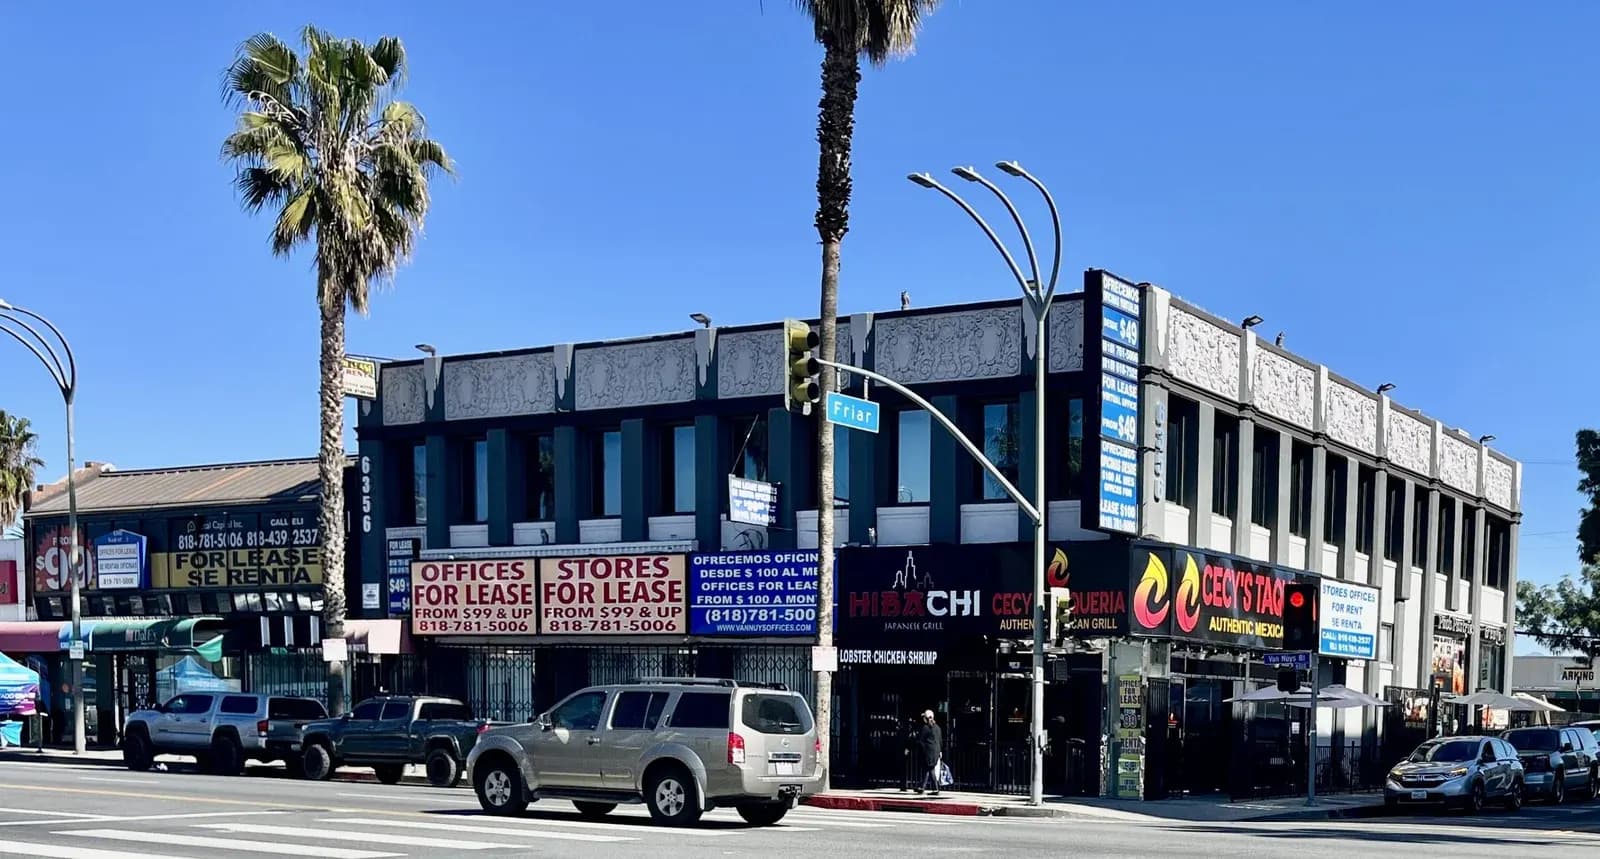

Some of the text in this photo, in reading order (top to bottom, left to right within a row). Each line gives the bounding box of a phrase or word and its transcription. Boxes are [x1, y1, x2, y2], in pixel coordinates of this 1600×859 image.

[1120, 317, 1137, 346] $49
[1103, 375, 1138, 398] FOR LEASE
[834, 401, 872, 423] Friar
[1118, 413, 1136, 442] $49
[362, 456, 372, 533] 6356
[1100, 499, 1119, 515] LEASE
[271, 517, 304, 527] CALL ELI
[53, 537, 73, 547] FRO
[176, 548, 319, 572] FOR LEASE
[693, 553, 818, 566] OFRECEMOS OFICIN
[421, 562, 525, 582] OFFICES
[557, 557, 670, 580] STORES
[700, 566, 818, 579] DESDE $ 100 AL ME
[187, 566, 312, 588] SE RENTA
[389, 578, 406, 593] $49
[544, 580, 682, 604] FOR LEASE
[701, 580, 818, 592] OFFICES FOR LEAS
[1202, 563, 1285, 618] CECY'S TAQ
[414, 583, 533, 606] FOR LEASE
[696, 594, 818, 605] FROM $ 100 A MON
[1322, 585, 1376, 603] STORES OFFICES
[849, 589, 981, 617] HIBACHI
[992, 592, 1033, 616] CECY
[1332, 602, 1363, 616] FOR RENT
[415, 607, 533, 619] FROM $99 & UP
[544, 606, 682, 619] FROM $99 & UP
[705, 608, 816, 625] (818)781-500
[419, 620, 529, 632] 818-781-5006
[550, 619, 676, 632] 818-781-5006
[716, 624, 812, 632] WWW.VANNUYSOFFICES.COM
[884, 622, 944, 632] JAPANESE GRILL
[1091, 617, 1118, 630] GRILL
[1208, 616, 1284, 639] AUTHENTIC MEXICA
[1340, 618, 1362, 631] RENTA
[1269, 655, 1280, 663] Van
[1281, 655, 1297, 663] Nuys
